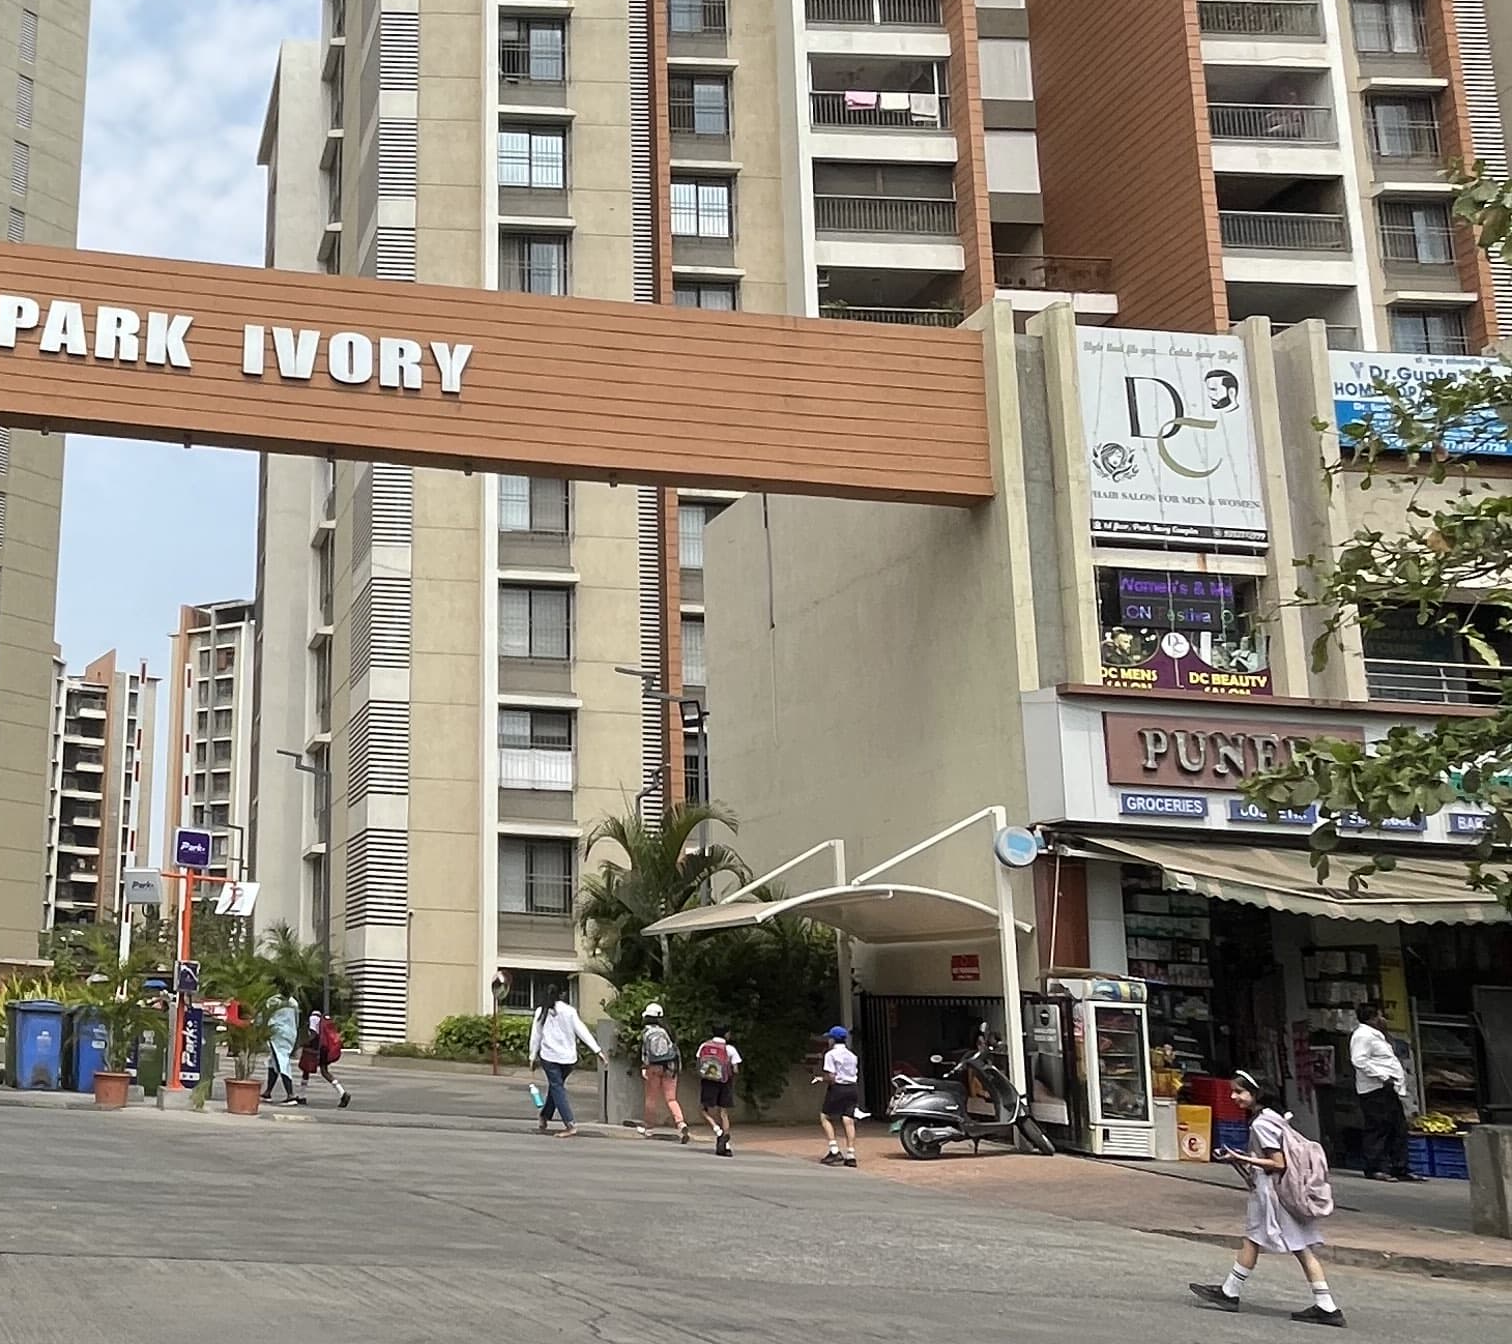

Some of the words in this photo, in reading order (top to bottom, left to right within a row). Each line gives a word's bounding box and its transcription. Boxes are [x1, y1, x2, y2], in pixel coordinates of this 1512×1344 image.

[243, 324, 473, 393] IVORY
[1121, 493, 1155, 503] SALON
[1159, 494, 1179, 504] FOR
[1182, 496, 1205, 505] MEN
[1218, 498, 1261, 509] WOMEN
[1120, 668, 1158, 682] MENS
[1189, 672, 1210, 685] DC
[1211, 674, 1268, 687] BEAUTY
[1126, 796, 1204, 814] GROCERIES
